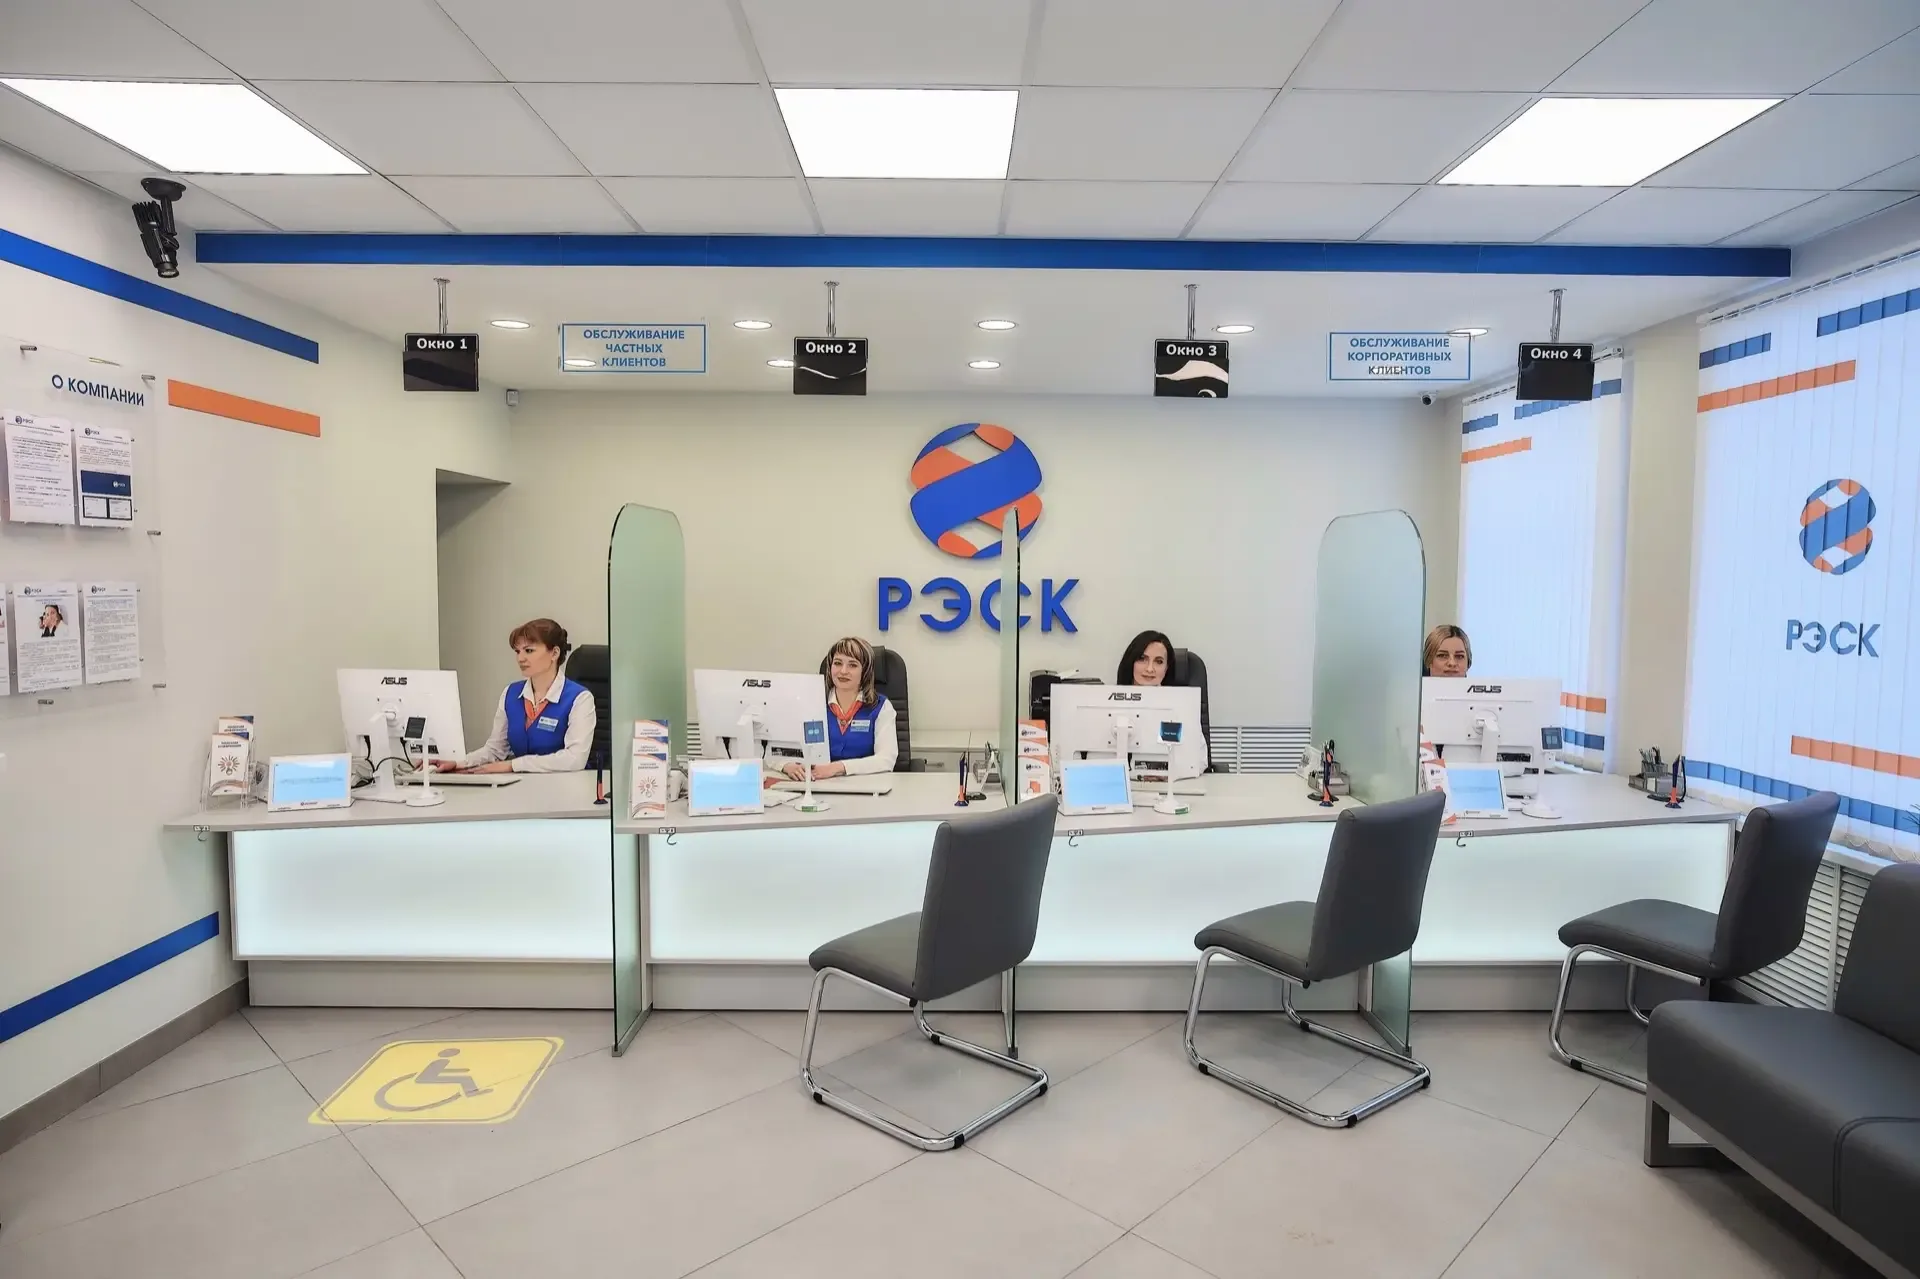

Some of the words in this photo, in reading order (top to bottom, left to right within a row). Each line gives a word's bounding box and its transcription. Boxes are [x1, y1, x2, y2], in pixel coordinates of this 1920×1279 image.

[583, 329, 685, 340] ОБСЛУЖИВАНИЕ
[416, 337, 455, 350] Окно
[460, 338, 468, 350] 1
[605, 343, 663, 353] ЧАСТНЫХ
[805, 341, 844, 354] Окно
[848, 342, 857, 354] 2
[1350, 337, 1450, 348] ОБСЛУЖИВАНИЕ
[1166, 343, 1204, 356] Окно
[1208, 345, 1217, 356] 3
[1530, 347, 1569, 359] Окно
[1572, 348, 1582, 359] 4
[1347, 351, 1452, 361] КОРПОРАТИВНЫХ
[602, 357, 666, 367] КЛИЕНТОВ
[1368, 365, 1431, 375] КЛИЕНТОВ
[51, 374, 64, 389] О
[67, 377, 144, 407] КОМПАНИИ
[878, 577, 1080, 632] РЭСК
[1786, 619, 1881, 658] РЭСК
[380, 676, 408, 686] ASUS
[742, 678, 771, 688] ASUS
[1466, 685, 1502, 694] ASUS
[1107, 692, 1142, 701] ASUS
